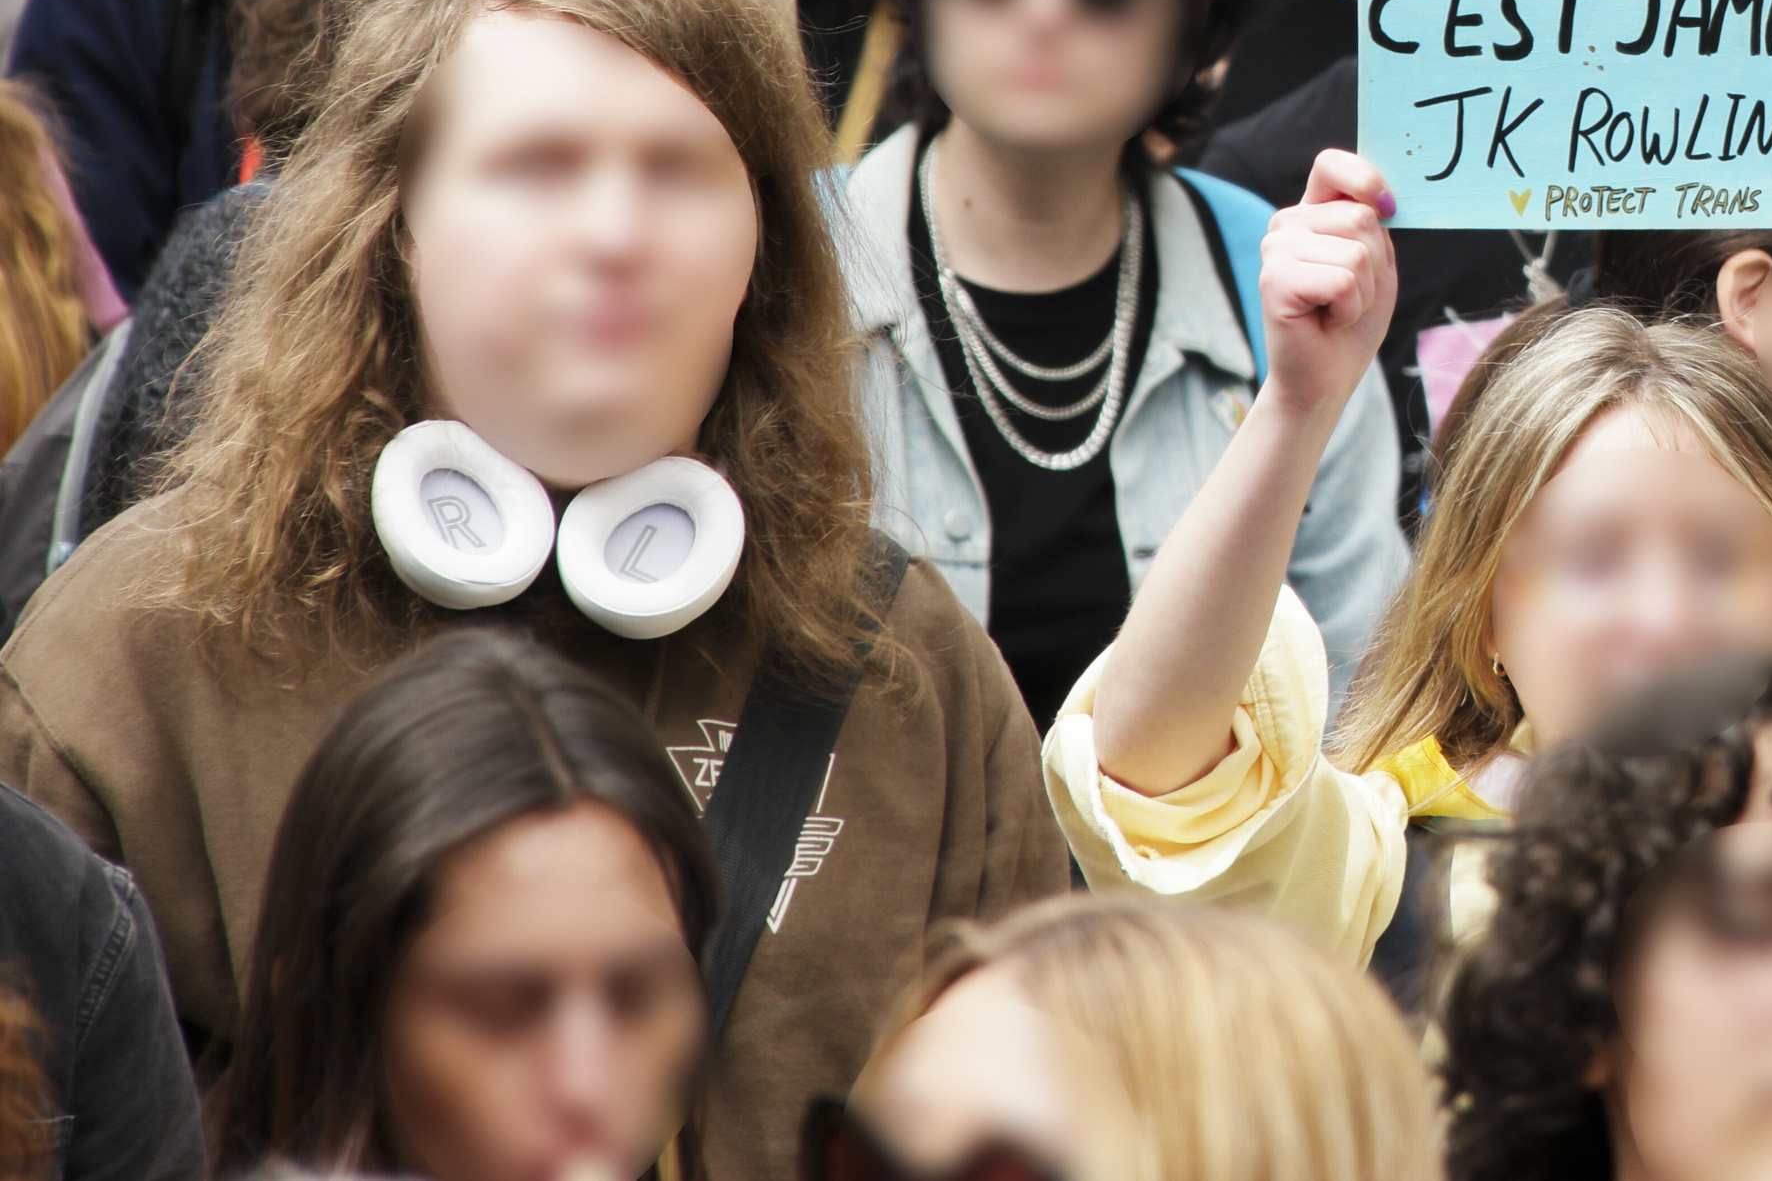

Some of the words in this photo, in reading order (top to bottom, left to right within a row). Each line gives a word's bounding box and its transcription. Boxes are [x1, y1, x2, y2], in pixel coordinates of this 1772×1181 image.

[1544, 184, 1657, 221] PROTECT
[1674, 182, 1763, 219] TRANS
[425, 494, 488, 551] R
[618, 523, 660, 585] L
